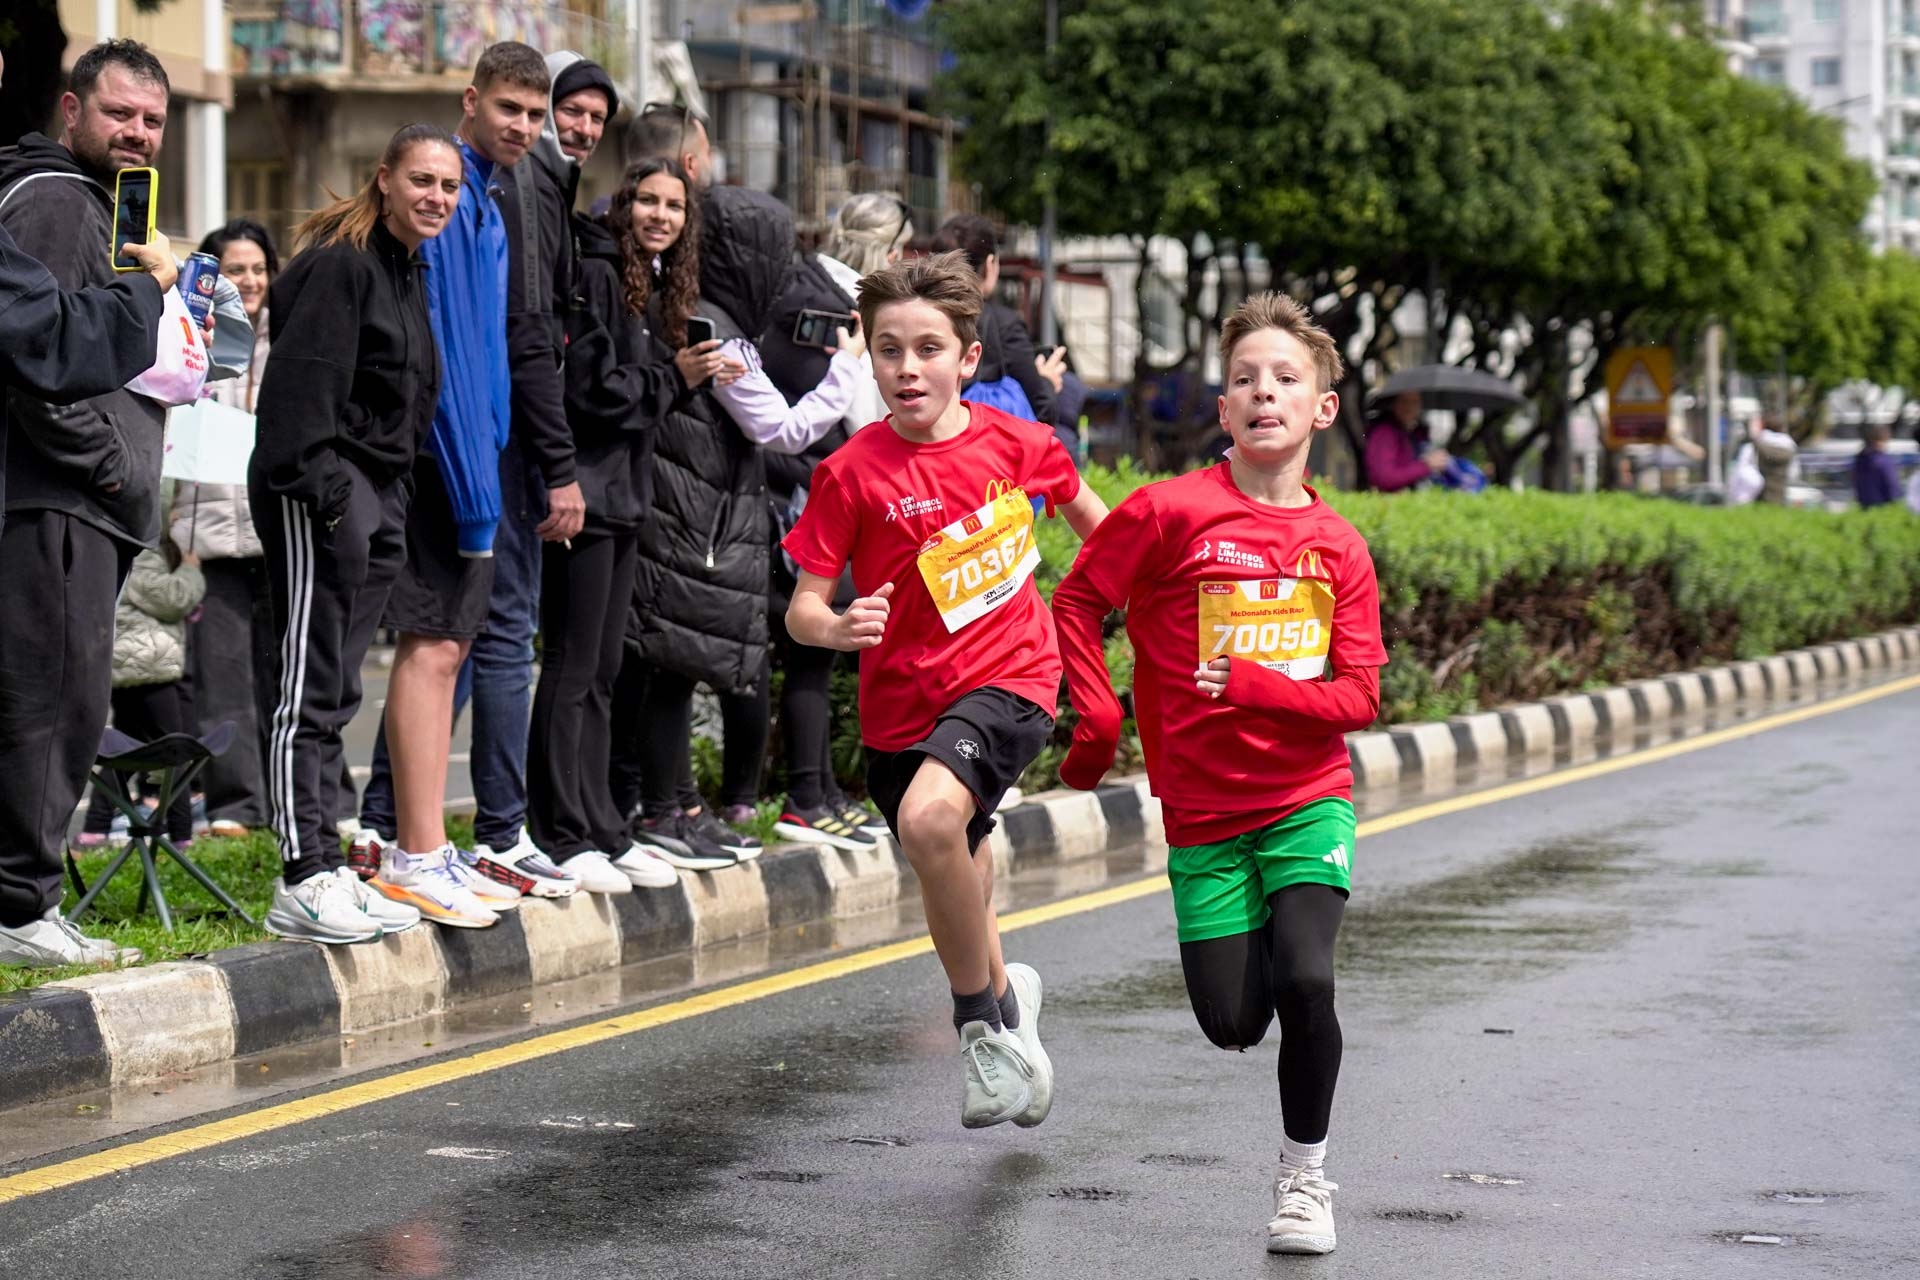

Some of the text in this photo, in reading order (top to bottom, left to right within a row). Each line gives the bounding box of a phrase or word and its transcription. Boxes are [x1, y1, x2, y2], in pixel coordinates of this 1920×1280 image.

[901, 498, 942, 513] LIMASSOL
[903, 504, 943, 519] MARATHON
[947, 541, 984, 563] McDonald's
[983, 532, 998, 544] Kids
[940, 523, 1029, 601] 70367
[1216, 556, 1265, 569] MARATHON
[1217, 548, 1265, 564] LIMASSOL
[1230, 609, 1272, 617] McDonald's
[1272, 607, 1288, 616] Kids
[1212, 618, 1321, 654] 70050
